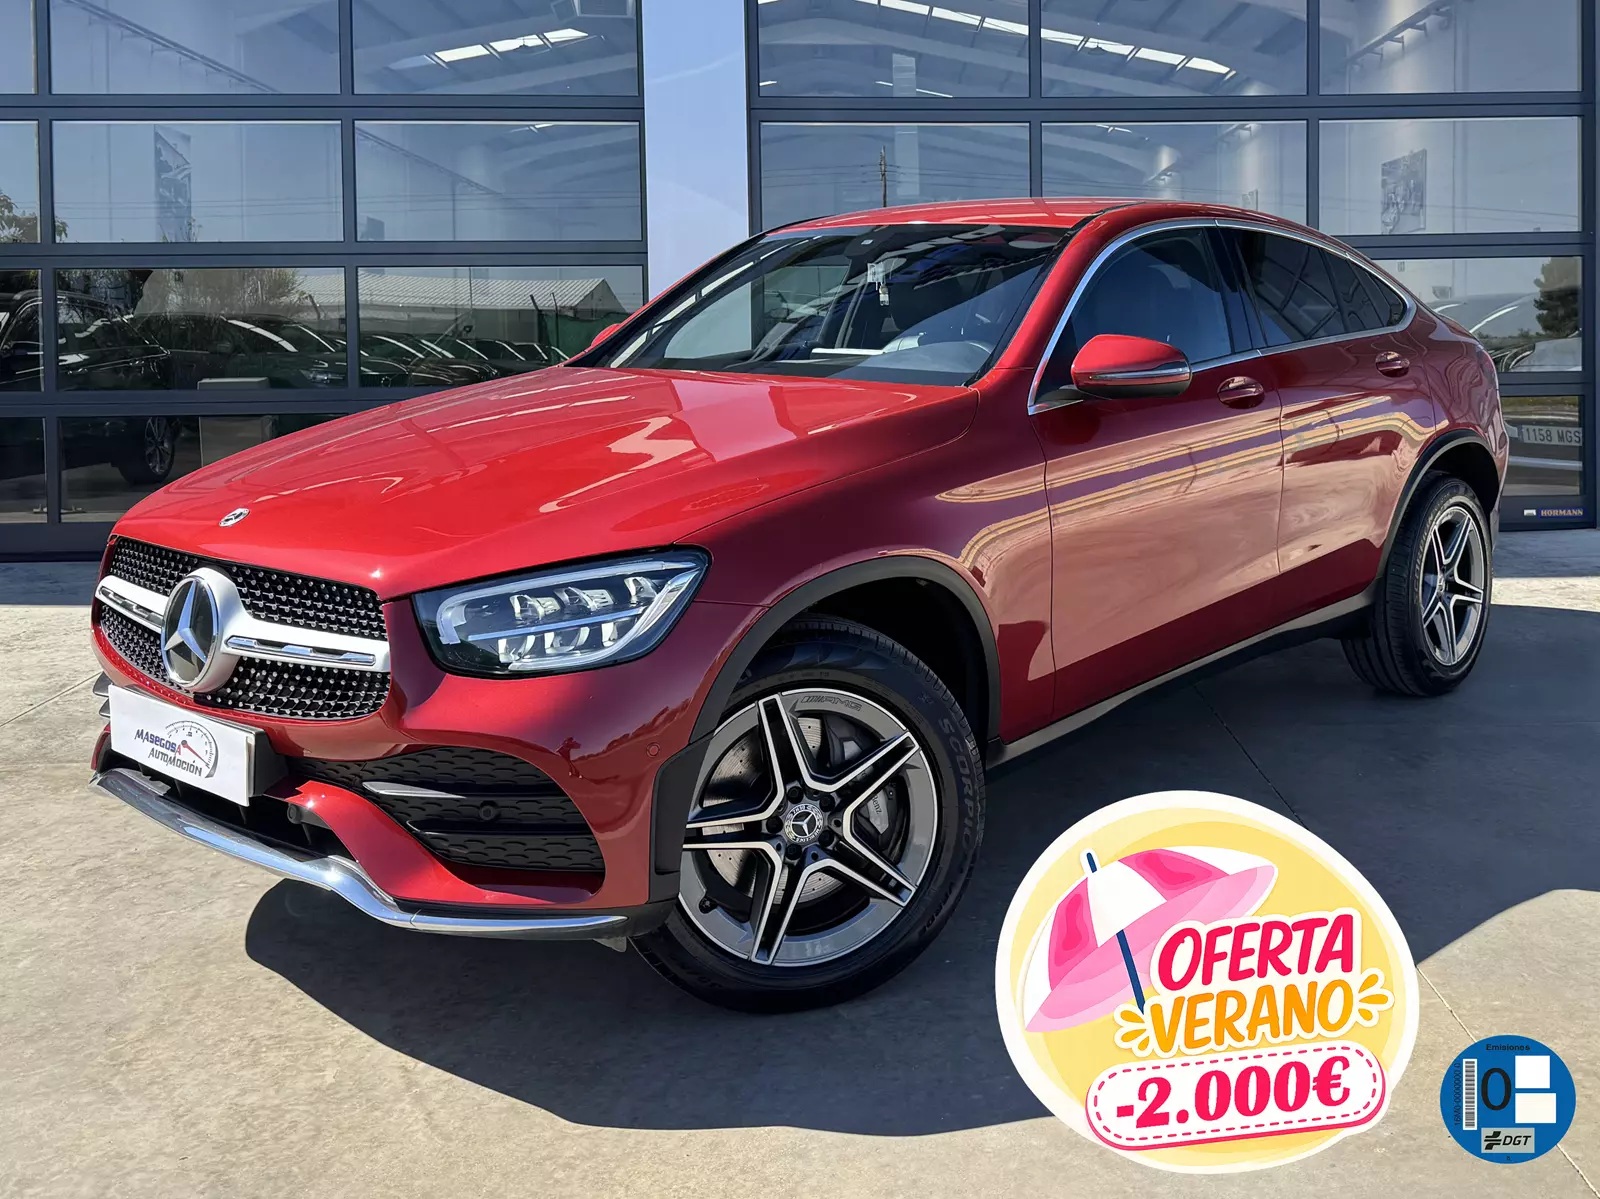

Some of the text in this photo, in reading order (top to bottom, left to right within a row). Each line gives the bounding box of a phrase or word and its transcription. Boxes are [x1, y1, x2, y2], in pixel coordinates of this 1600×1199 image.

[1526, 427, 1581, 443] 1158 MGS
[148, 747, 203, 776] AUTOMOCIÓN
